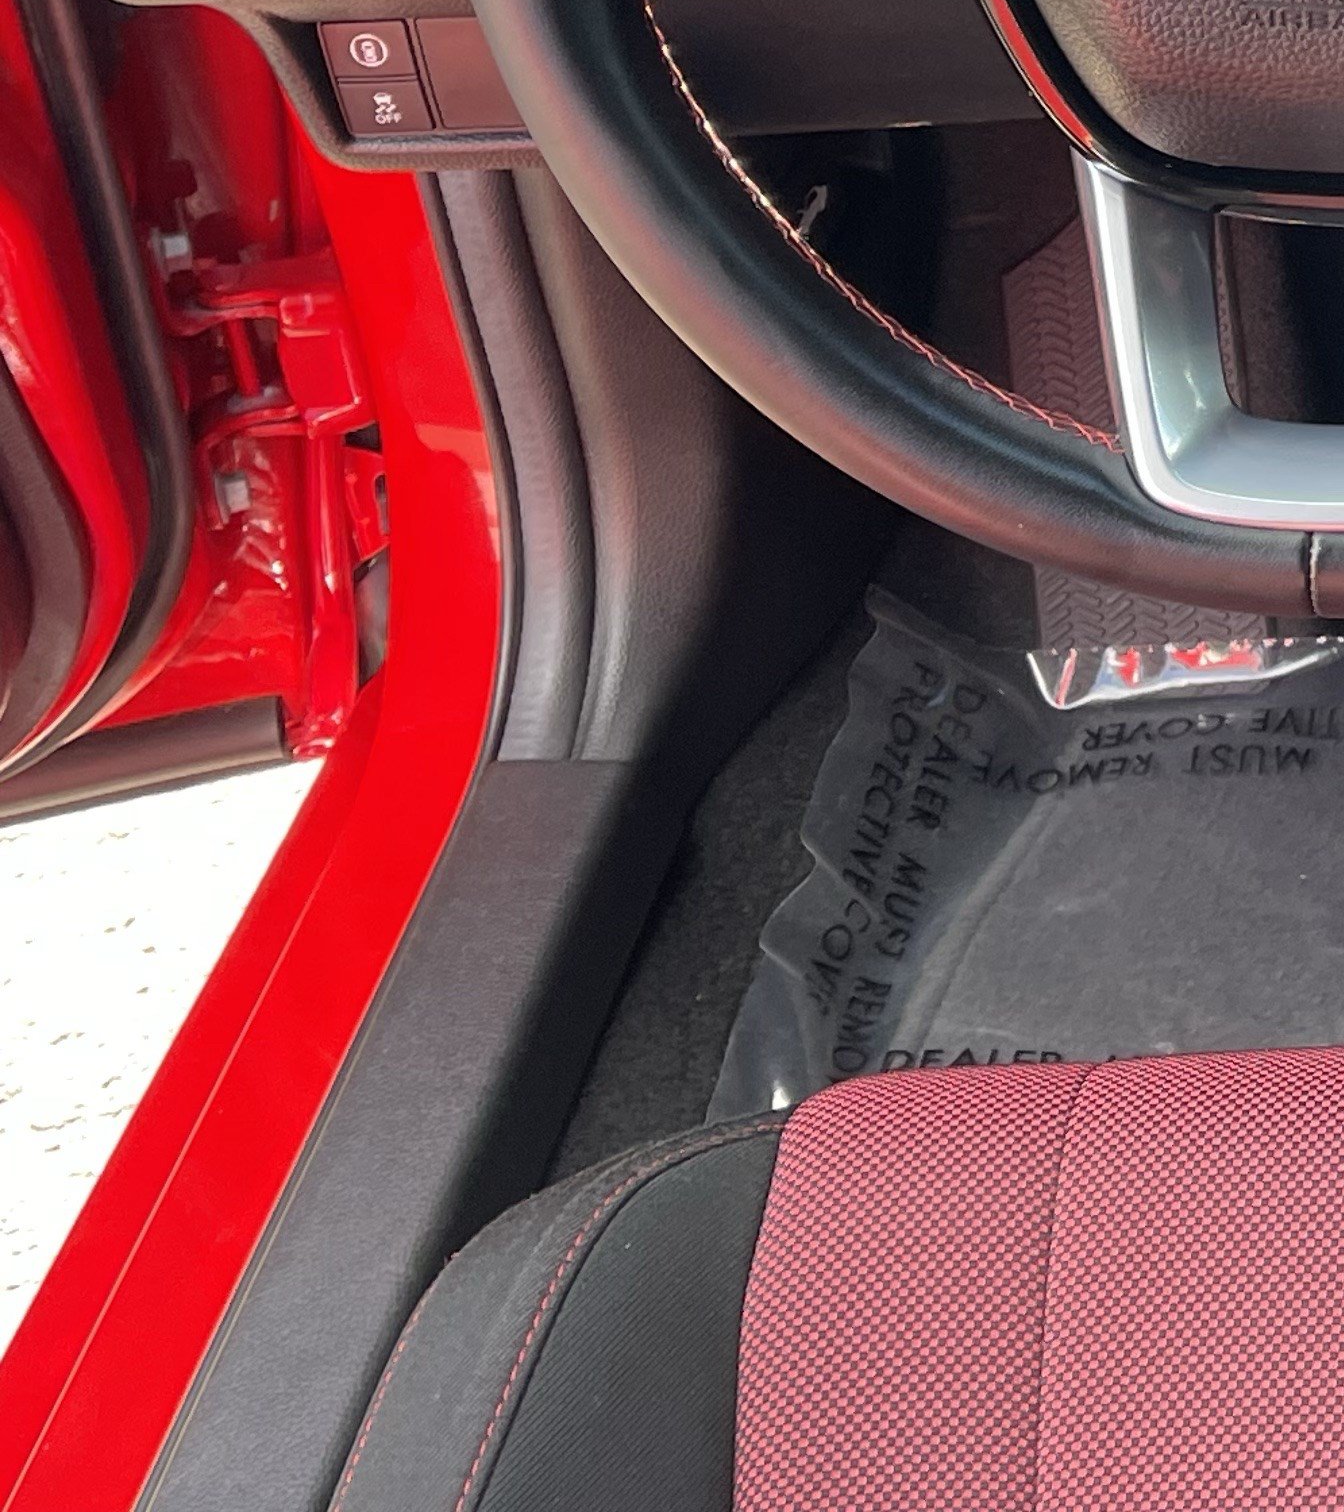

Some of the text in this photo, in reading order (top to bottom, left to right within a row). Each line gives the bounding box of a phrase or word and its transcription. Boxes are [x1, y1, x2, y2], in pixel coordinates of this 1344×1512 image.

[374, 113, 402, 125] OFF
[1082, 713, 1228, 753] COVER
[906, 681, 986, 832] DEALER
[972, 748, 1154, 796] REMOVE
[1184, 743, 1311, 777] MUST
[832, 975, 892, 1074] REMO
